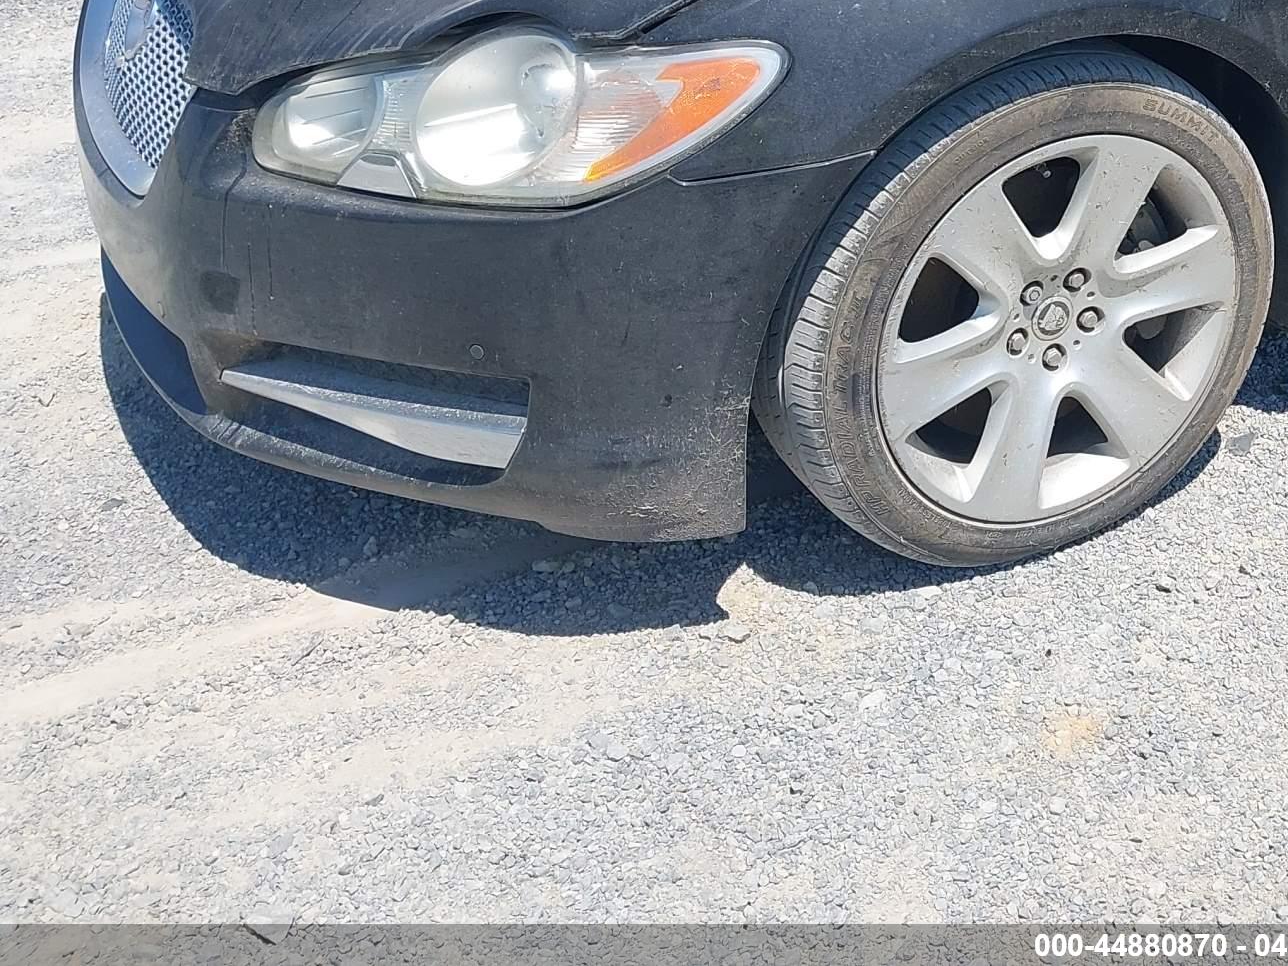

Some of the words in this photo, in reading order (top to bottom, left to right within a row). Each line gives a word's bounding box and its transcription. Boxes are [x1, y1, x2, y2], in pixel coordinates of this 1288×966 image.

[1143, 98, 1219, 144] SUMMIT
[832, 320, 855, 395] TRAC
[836, 400, 871, 488] RADIAL
[861, 490, 890, 516] HP
